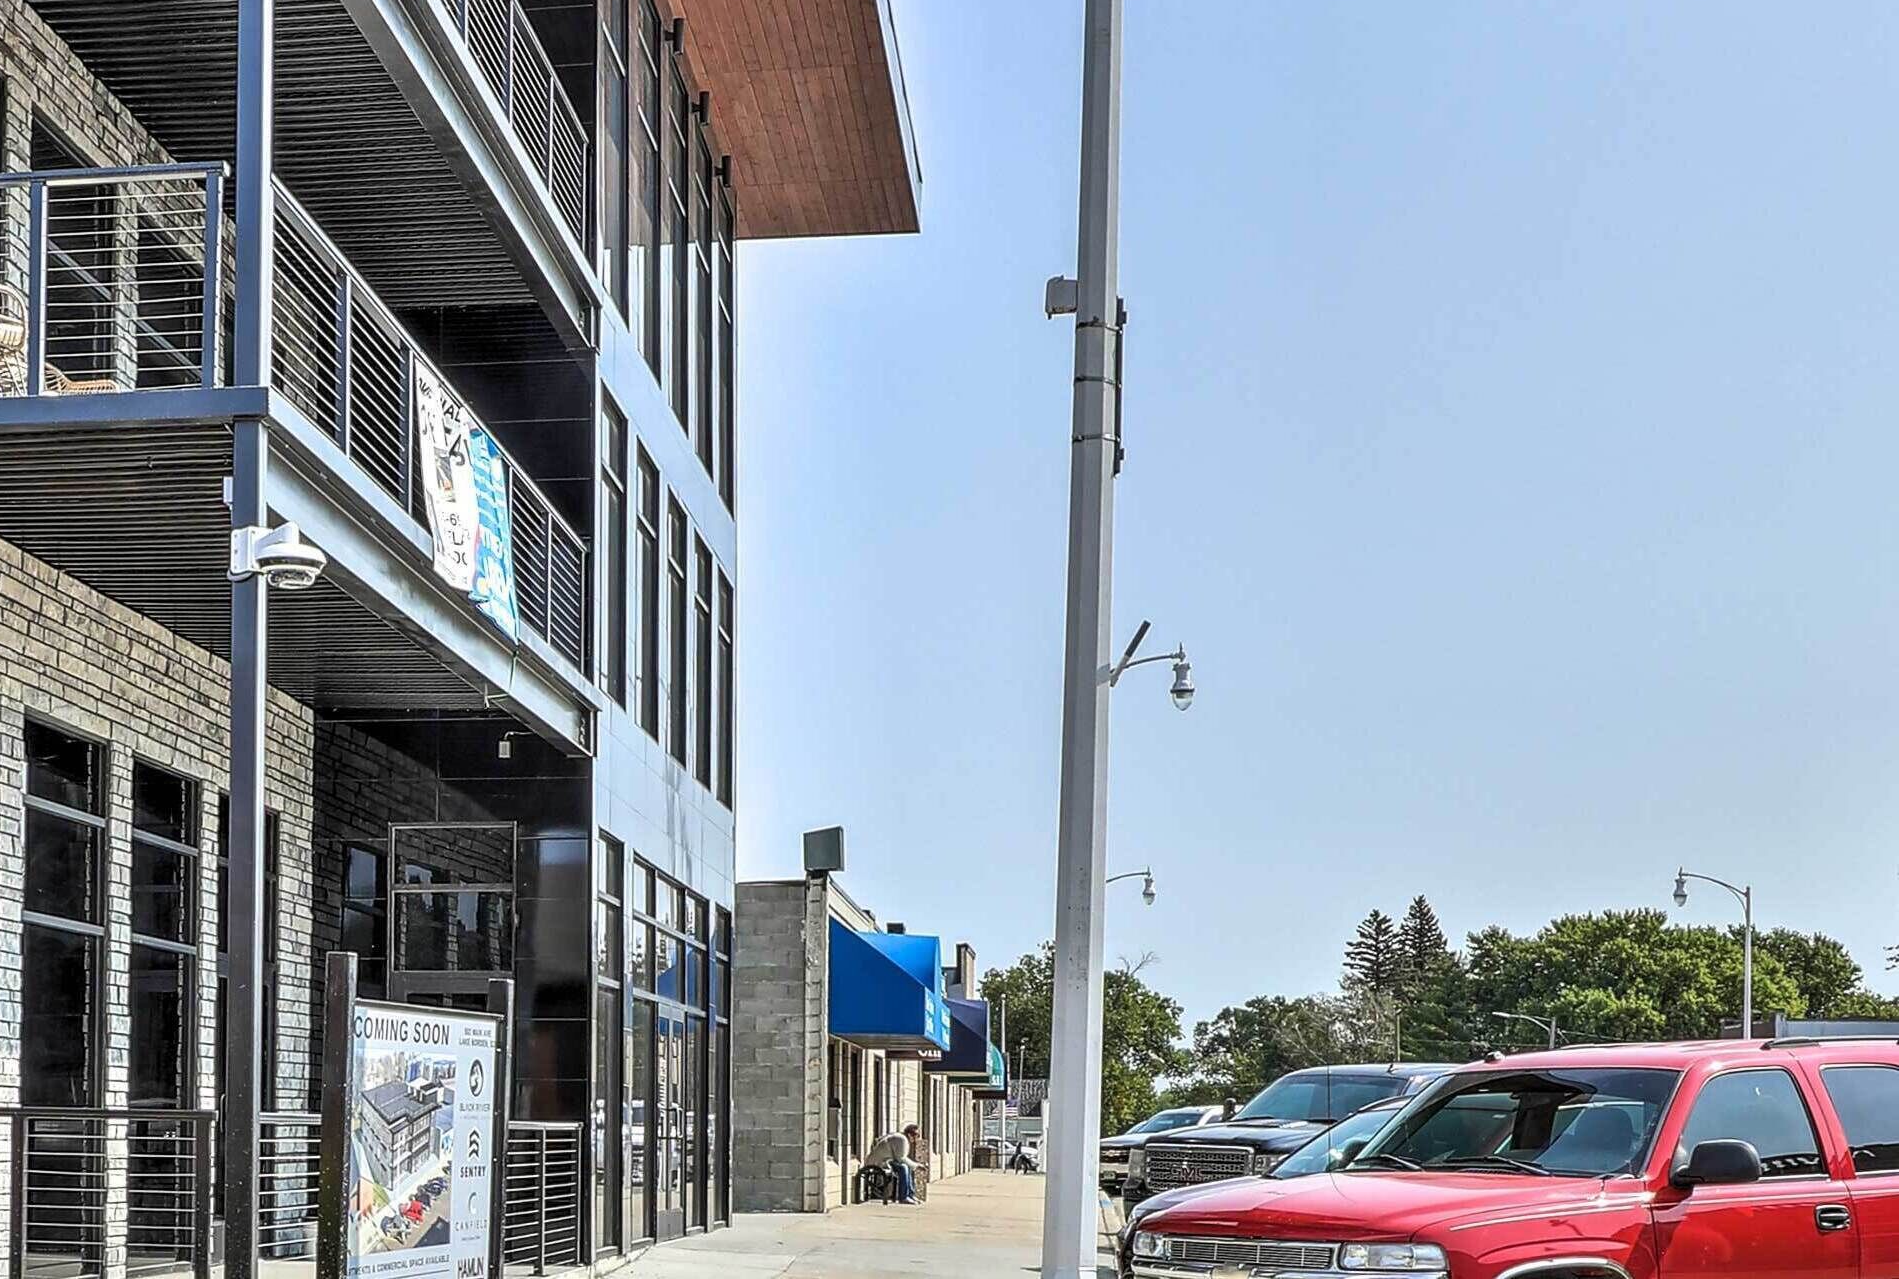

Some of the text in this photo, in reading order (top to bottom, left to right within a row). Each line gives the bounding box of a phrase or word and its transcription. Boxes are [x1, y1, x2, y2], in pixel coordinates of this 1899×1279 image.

[354, 1015, 450, 1046] COMING SOON
[460, 1165, 486, 1178] SENTRY
[1170, 1165, 1205, 1182] GMC
[455, 1219, 488, 1232] CANFIELD
